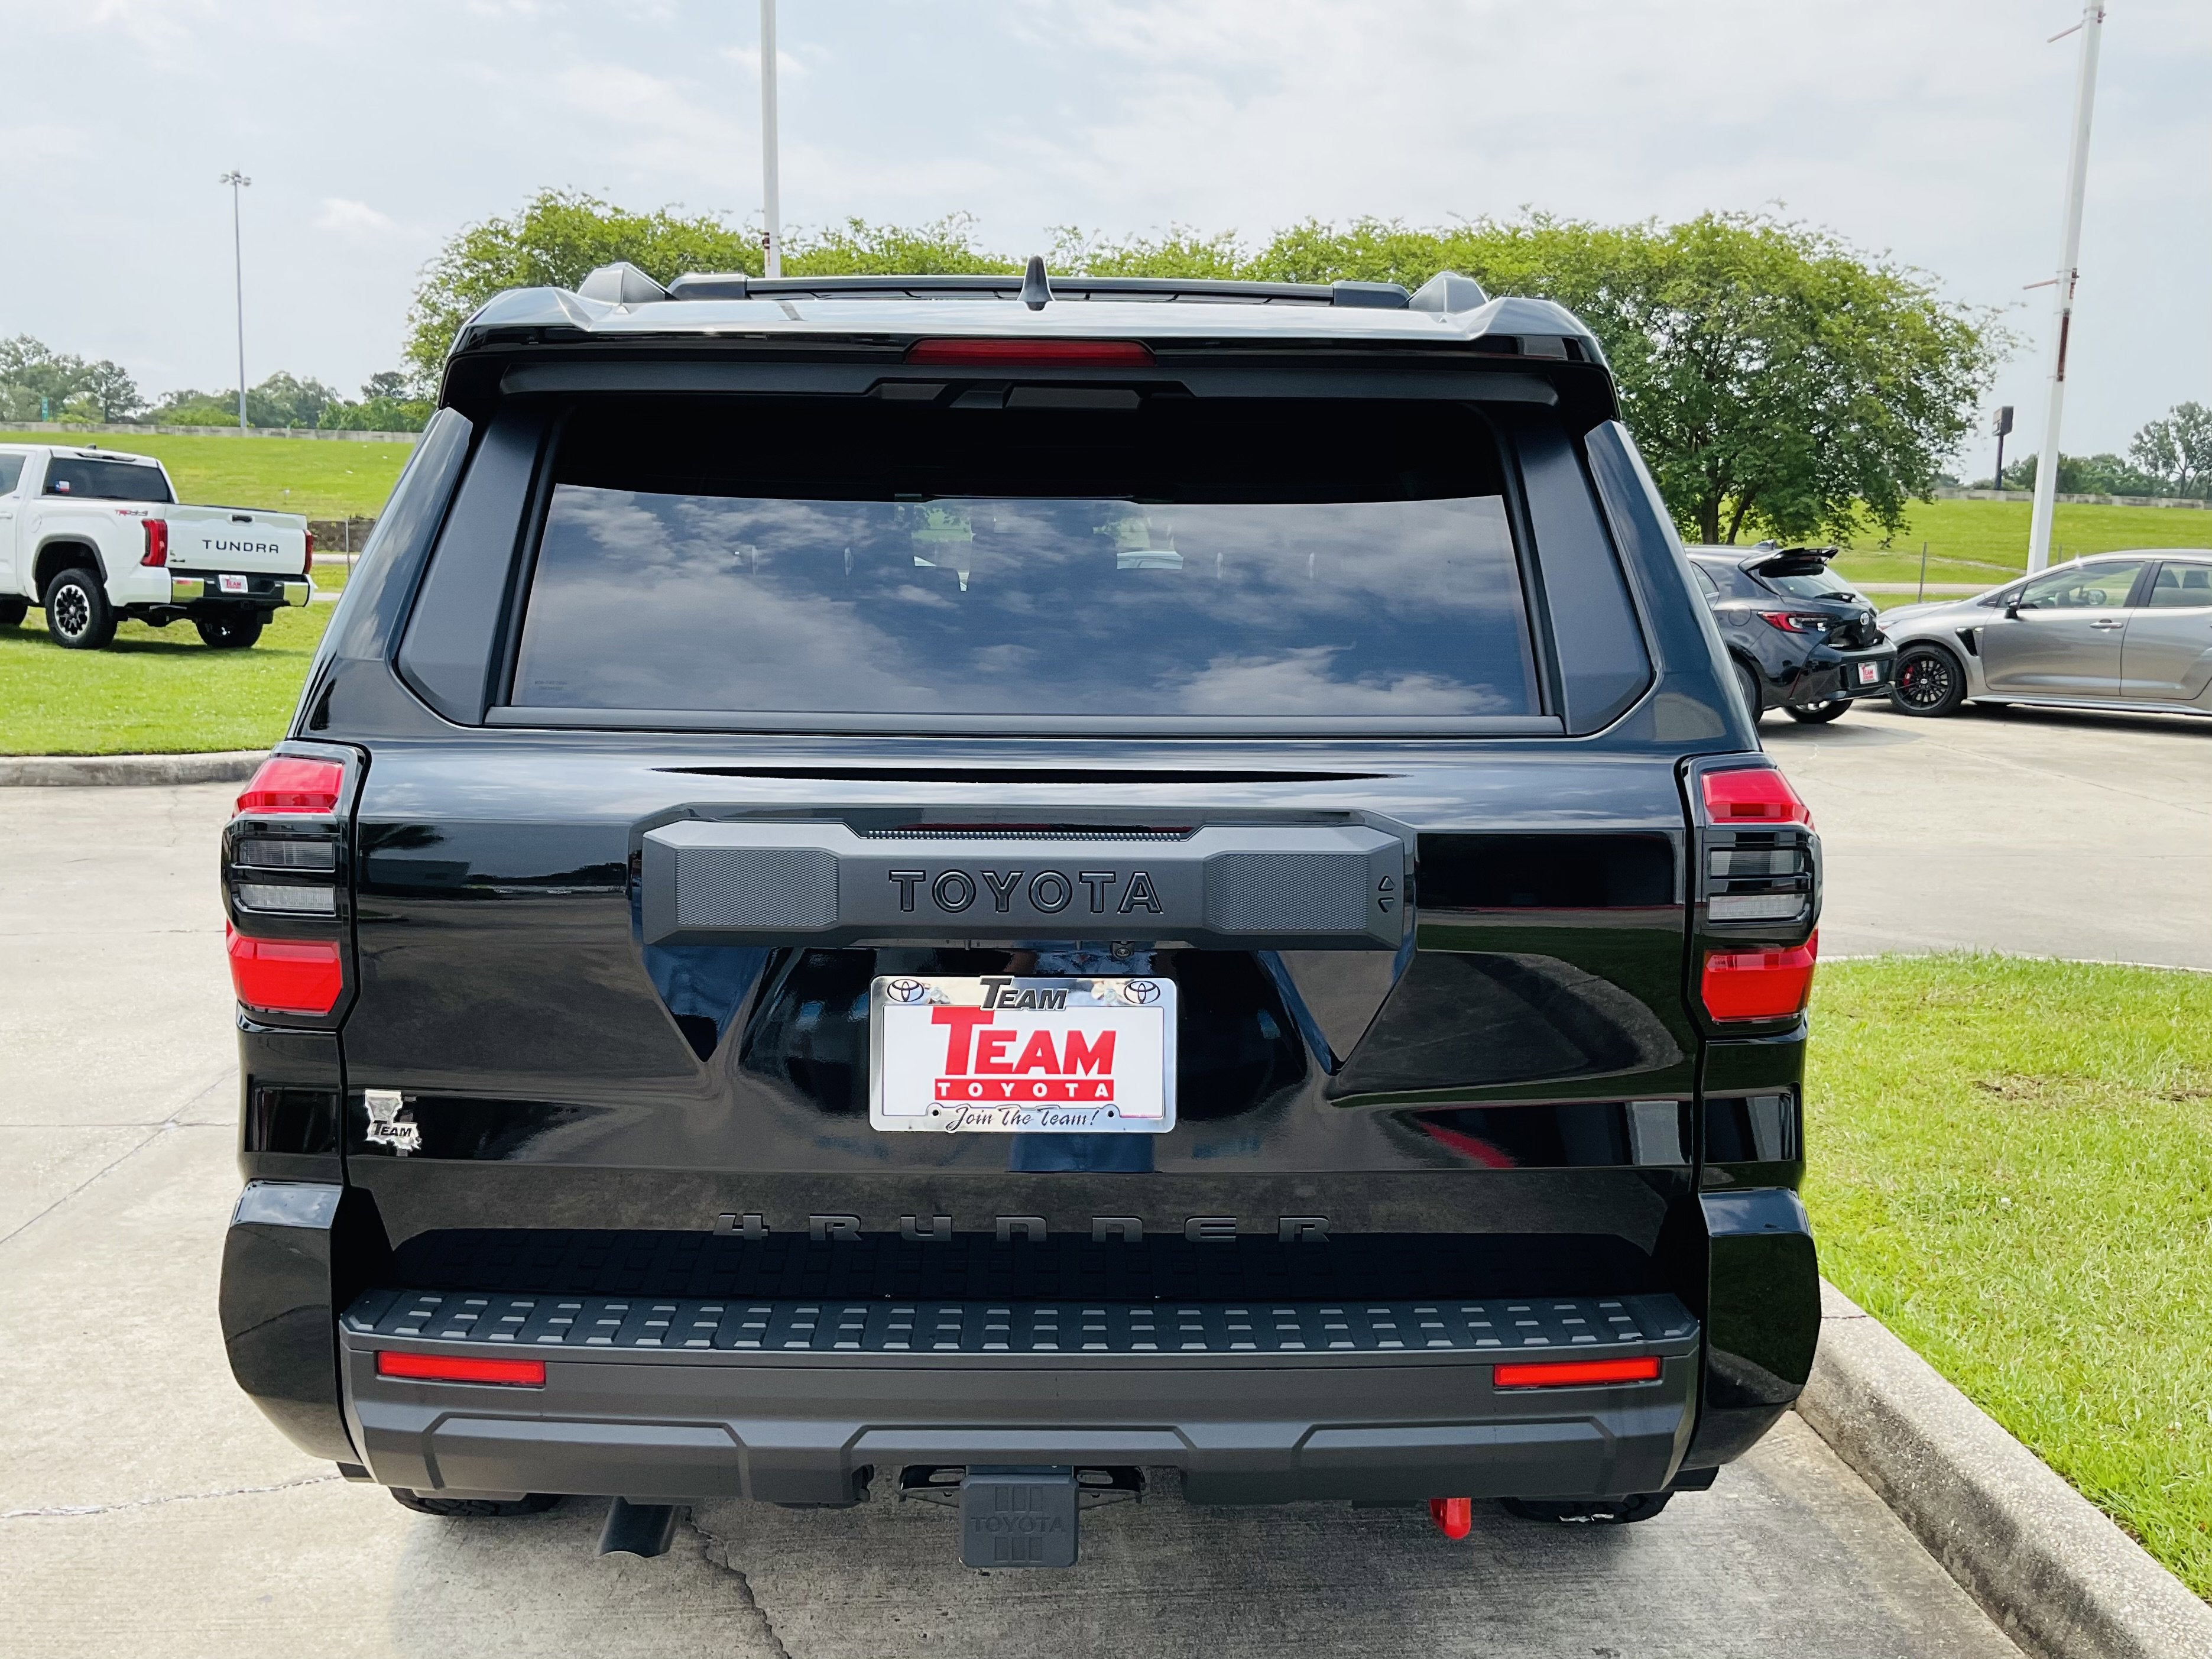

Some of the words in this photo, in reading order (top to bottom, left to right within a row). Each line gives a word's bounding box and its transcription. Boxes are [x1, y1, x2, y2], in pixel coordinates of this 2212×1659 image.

[202, 539, 279, 554] TUNDRA
[888, 869, 1163, 914] TOYOTA
[979, 977, 1068, 1010] TEAM
[931, 1007, 1117, 1077] TEAM
[937, 1083, 1110, 1098] TOYOTA
[373, 1120, 412, 1137] TEAM
[946, 1106, 993, 1131] Join
[998, 1107, 1033, 1126] The
[1037, 1107, 1099, 1126] Team!
[712, 1212, 1331, 1243] 4RUNNER
[971, 1516, 1065, 1533] TOYOTA
